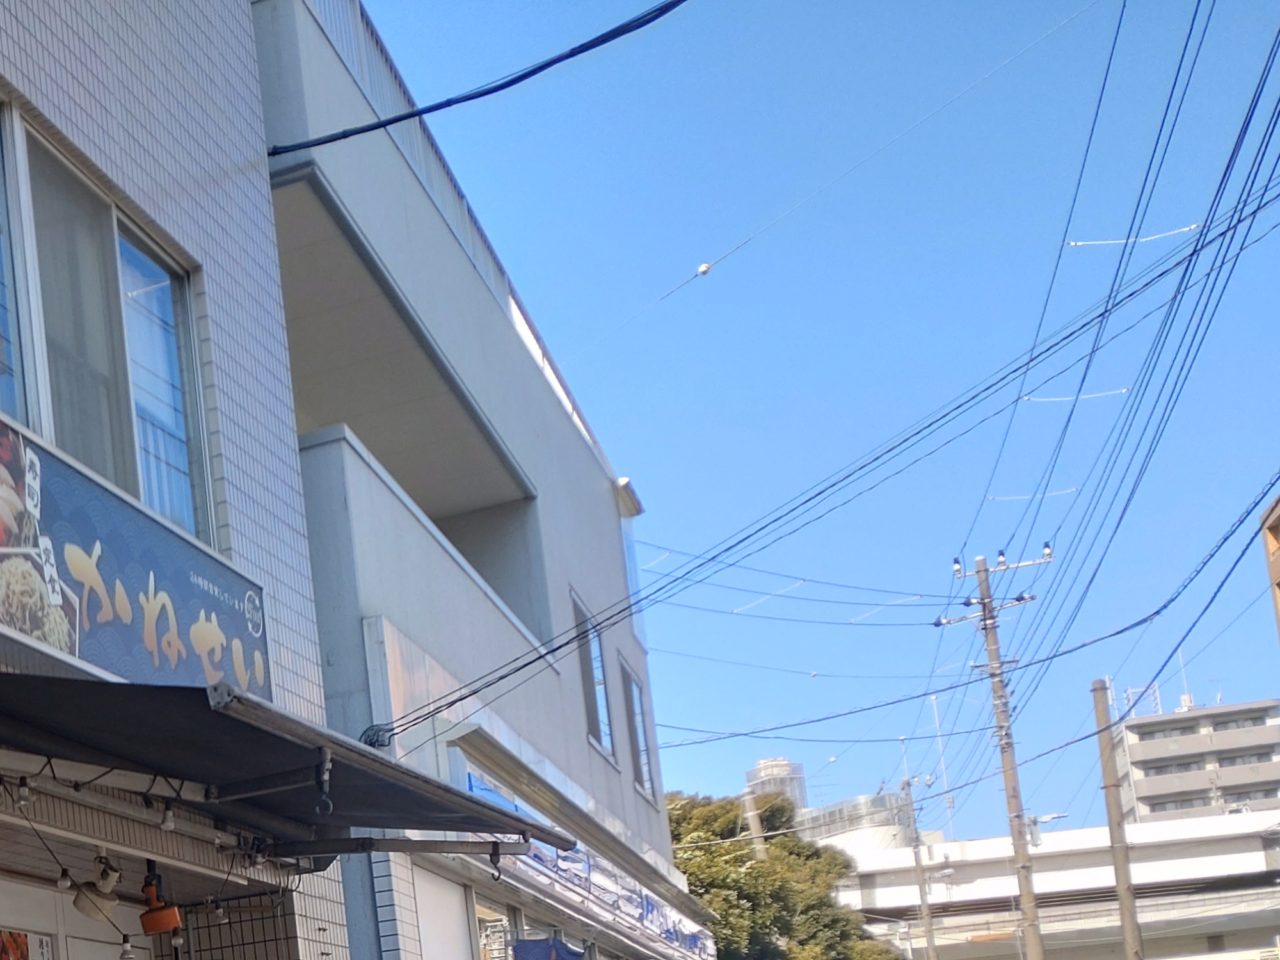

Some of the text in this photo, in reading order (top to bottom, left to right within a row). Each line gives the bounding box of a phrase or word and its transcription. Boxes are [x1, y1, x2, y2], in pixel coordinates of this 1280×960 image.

[42, 545, 61, 597] 定食
[64, 540, 266, 692] かねせい
